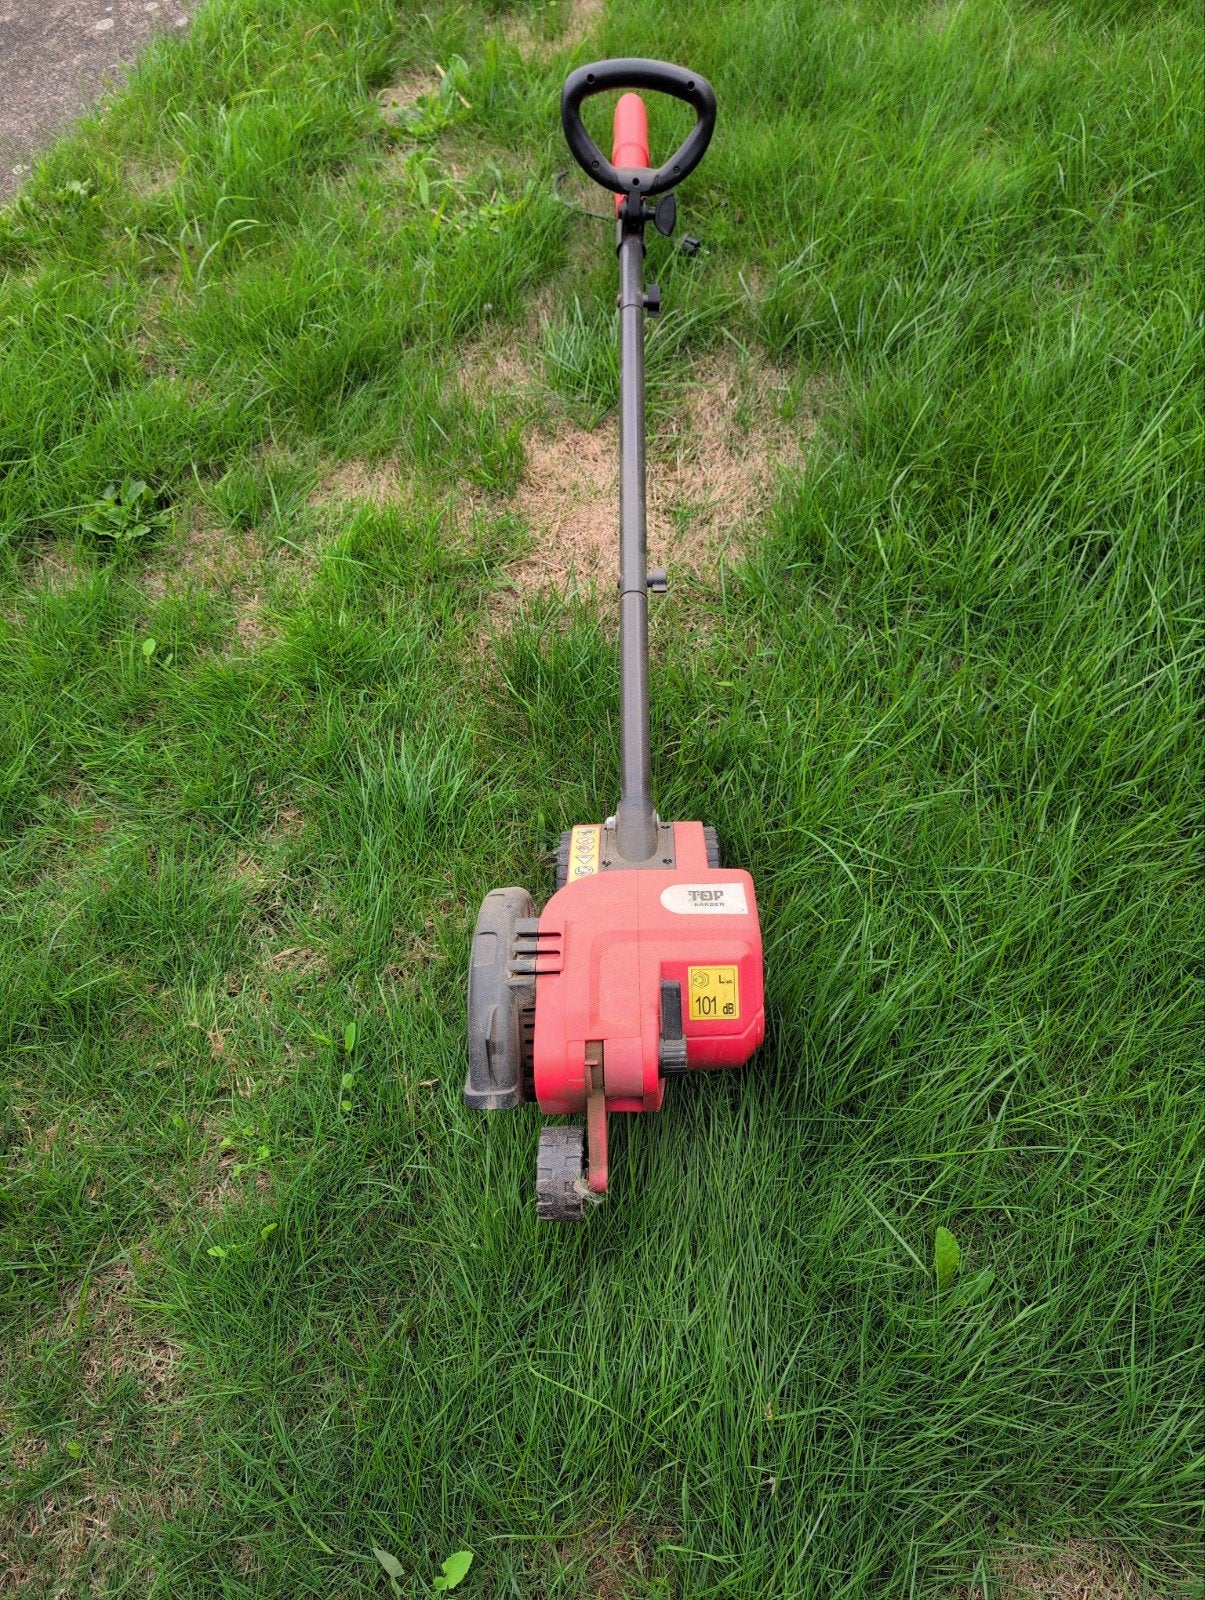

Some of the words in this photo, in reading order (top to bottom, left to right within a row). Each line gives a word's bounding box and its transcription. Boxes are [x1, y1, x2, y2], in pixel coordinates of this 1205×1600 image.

[688, 890, 724, 901] TOP
[695, 996, 717, 1015] 101
[722, 1002, 734, 1015] dB
